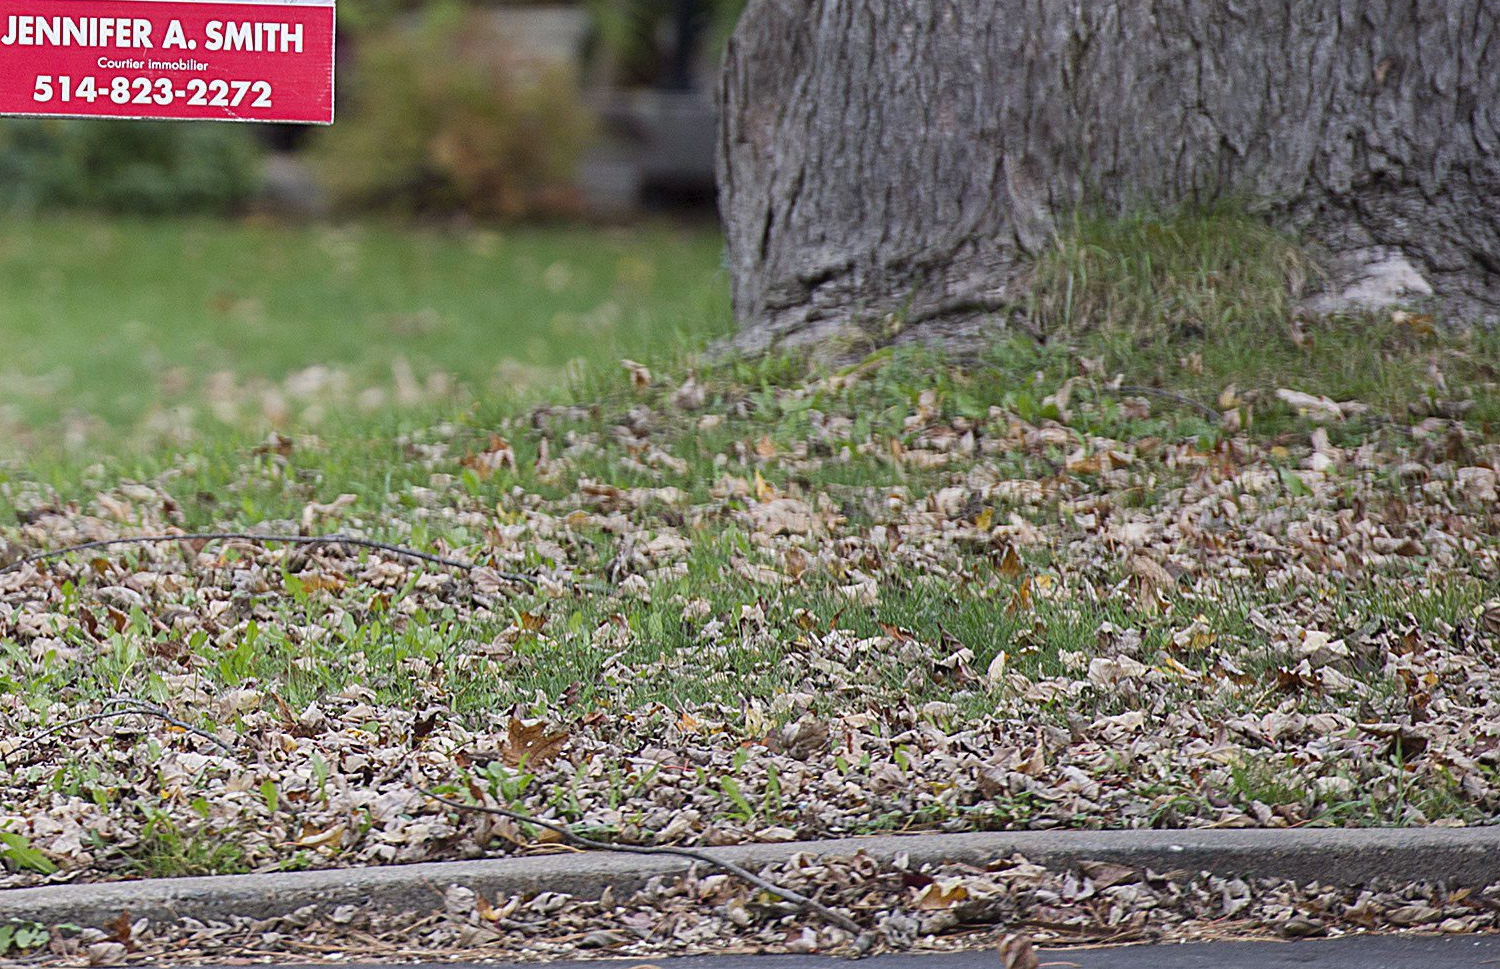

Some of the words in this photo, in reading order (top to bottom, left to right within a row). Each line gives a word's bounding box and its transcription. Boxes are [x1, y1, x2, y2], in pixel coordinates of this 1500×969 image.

[0, 15, 153, 49] JENNIFER
[161, 19, 197, 50] A.
[205, 20, 304, 53] SMITH
[97, 56, 145, 69] Courtier
[148, 58, 209, 72] immobilier
[33, 75, 272, 108] 514-823-2272
